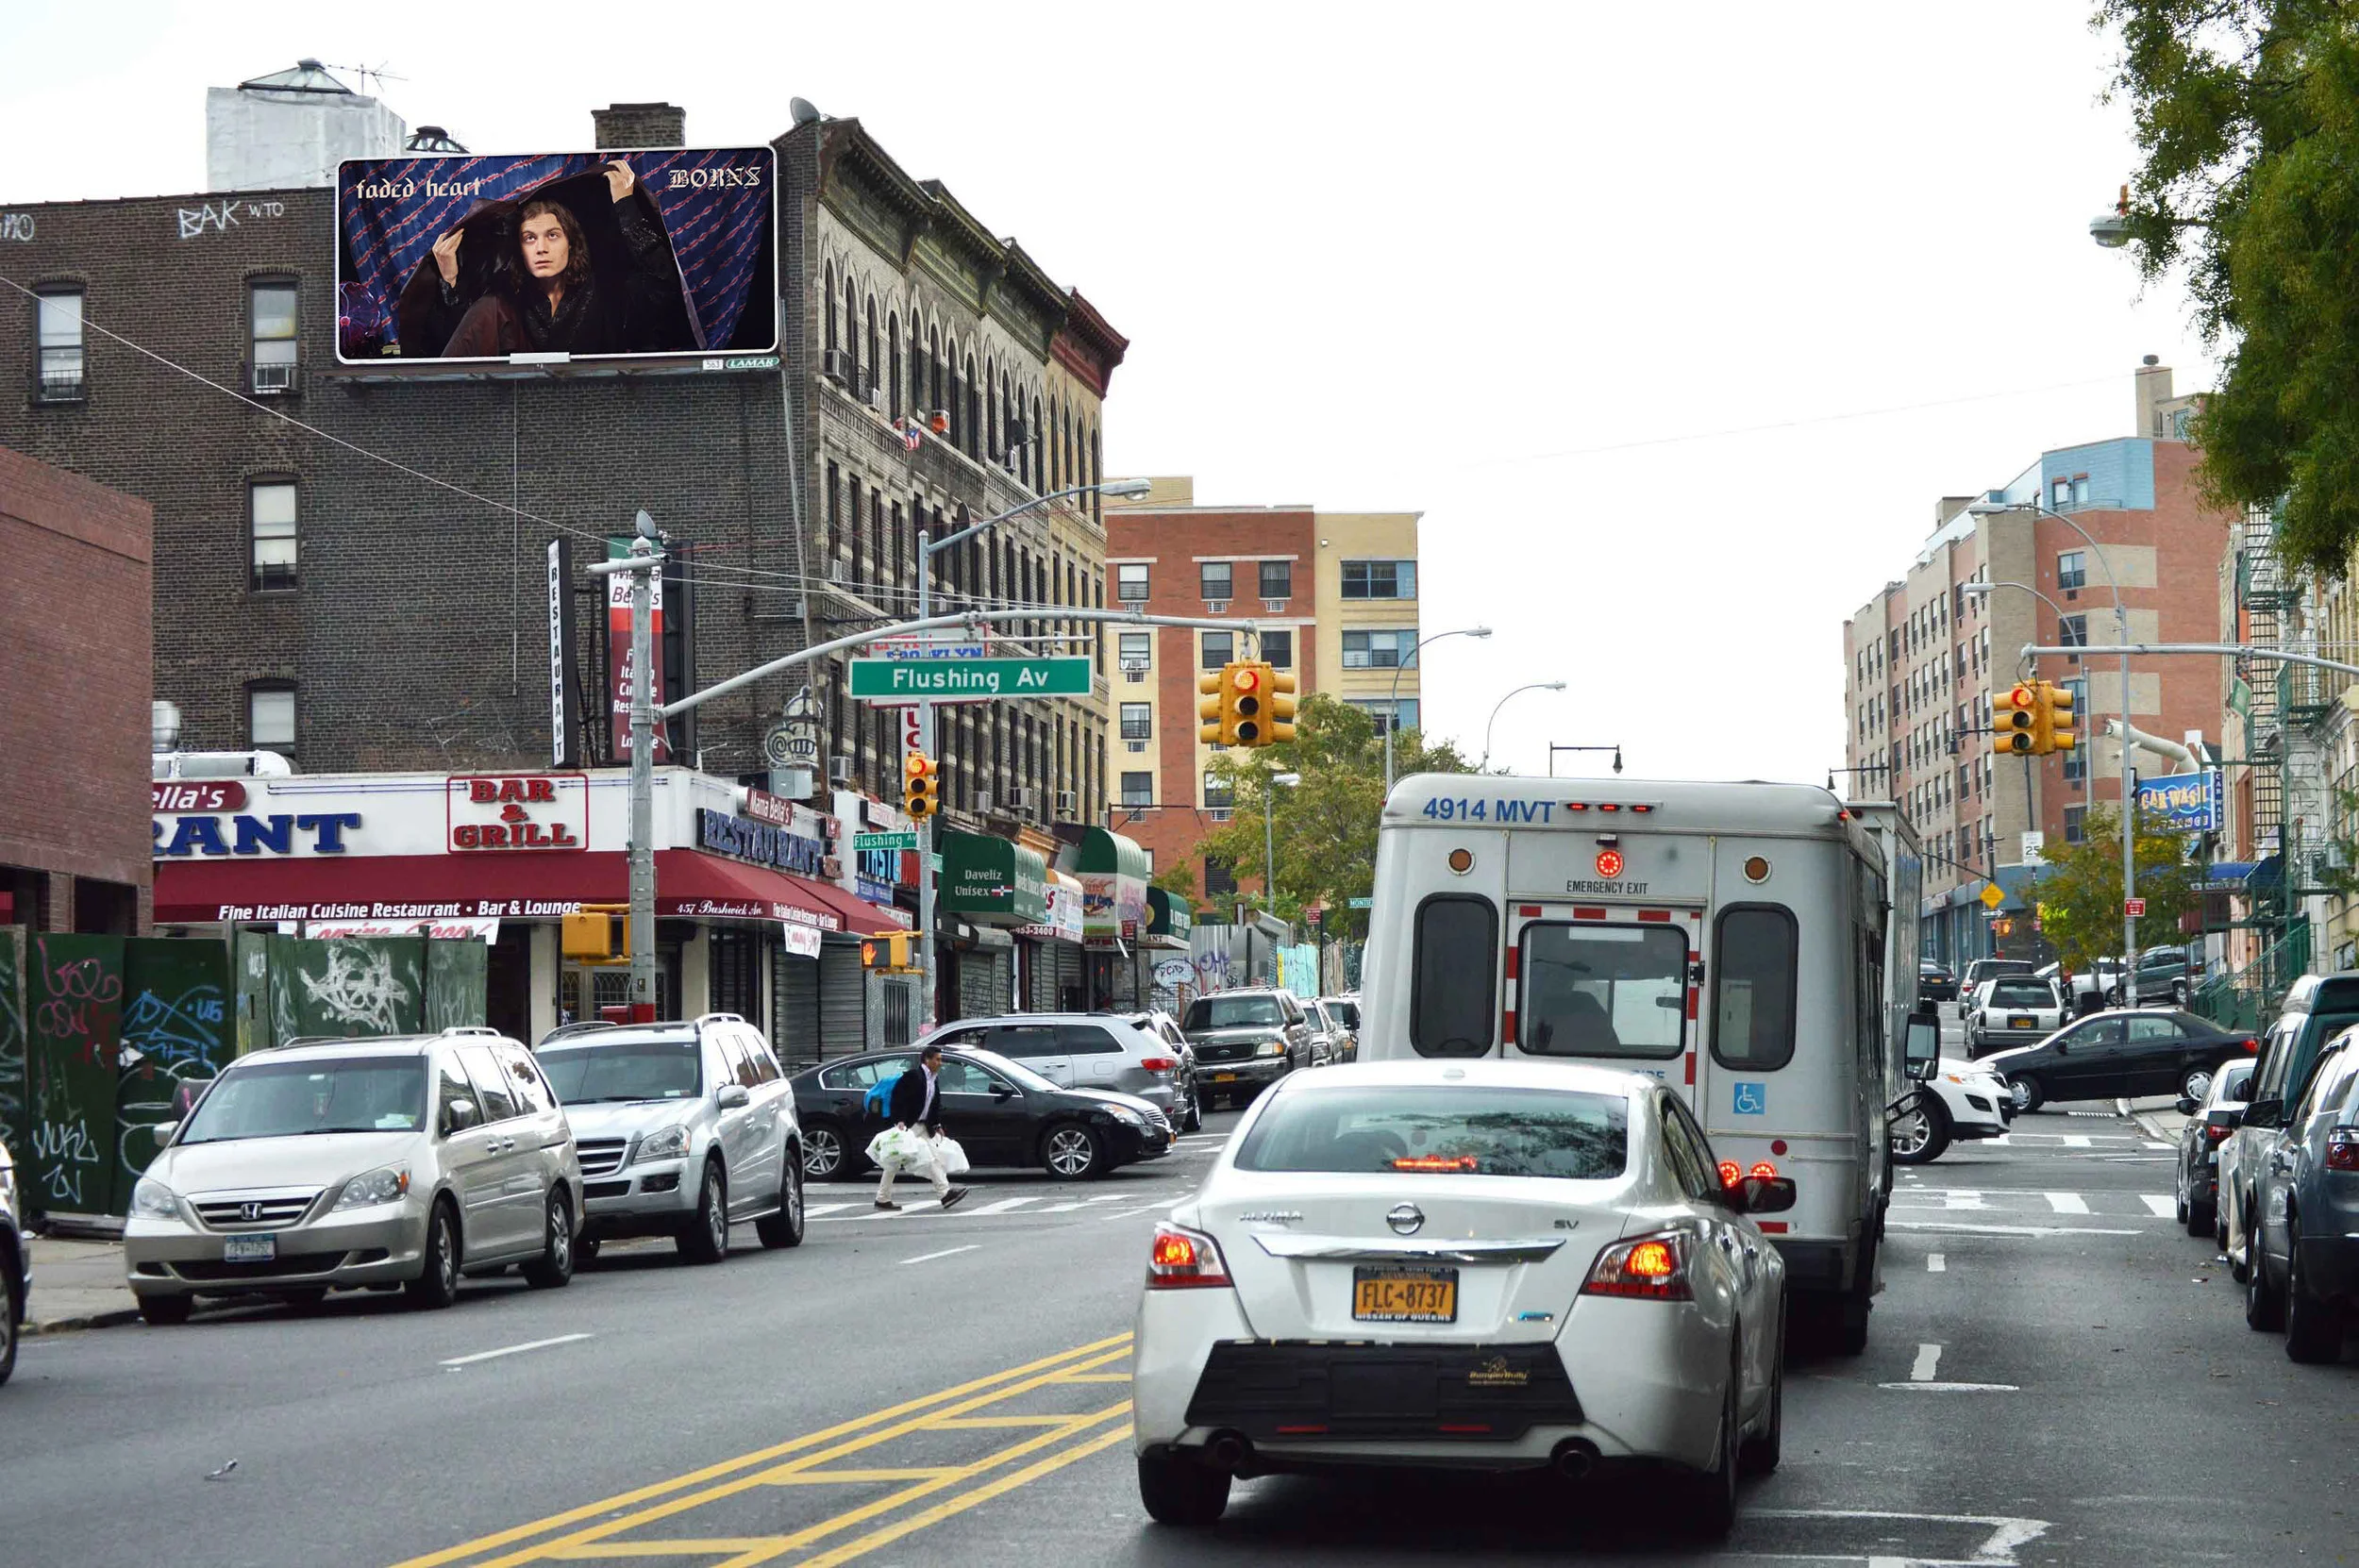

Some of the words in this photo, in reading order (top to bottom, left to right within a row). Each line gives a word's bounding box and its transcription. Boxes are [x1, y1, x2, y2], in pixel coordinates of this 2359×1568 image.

[356, 177, 414, 199] faded
[427, 177, 481, 197] heart
[729, 358, 774, 367] LAMAR
[551, 568, 563, 758] RESTAURANT
[893, 667, 1000, 692] Flushing
[1016, 667, 1048, 687] Av
[153, 786, 226, 809] ella's
[470, 779, 556, 803] BAR
[2141, 789, 2168, 810] CAR
[2168, 785, 2208, 809] WASH
[500, 804, 529, 823] &
[1423, 797, 1487, 821] 4914
[1496, 799, 1556, 823] MVT
[453, 823, 577, 848] GRILL
[704, 809, 821, 876] RESTAURANT
[854, 835, 903, 847] Flushing
[1566, 879, 1624, 893] EMERGENCY
[1627, 882, 1648, 894] EXIT
[218, 905, 253, 920] Fine
[256, 904, 308, 920] Italian
[310, 903, 368, 918] Cuisine
[372, 902, 460, 918] Restaurant
[478, 901, 507, 916] Bar
[509, 901, 521, 915] &
[525, 900, 582, 915] Lounge
[678, 904, 696, 915] 457
[698, 900, 746, 915] Bushwick
[1554, 1219, 1580, 1229] SV
[1356, 1312, 1391, 1321] NISSAN
